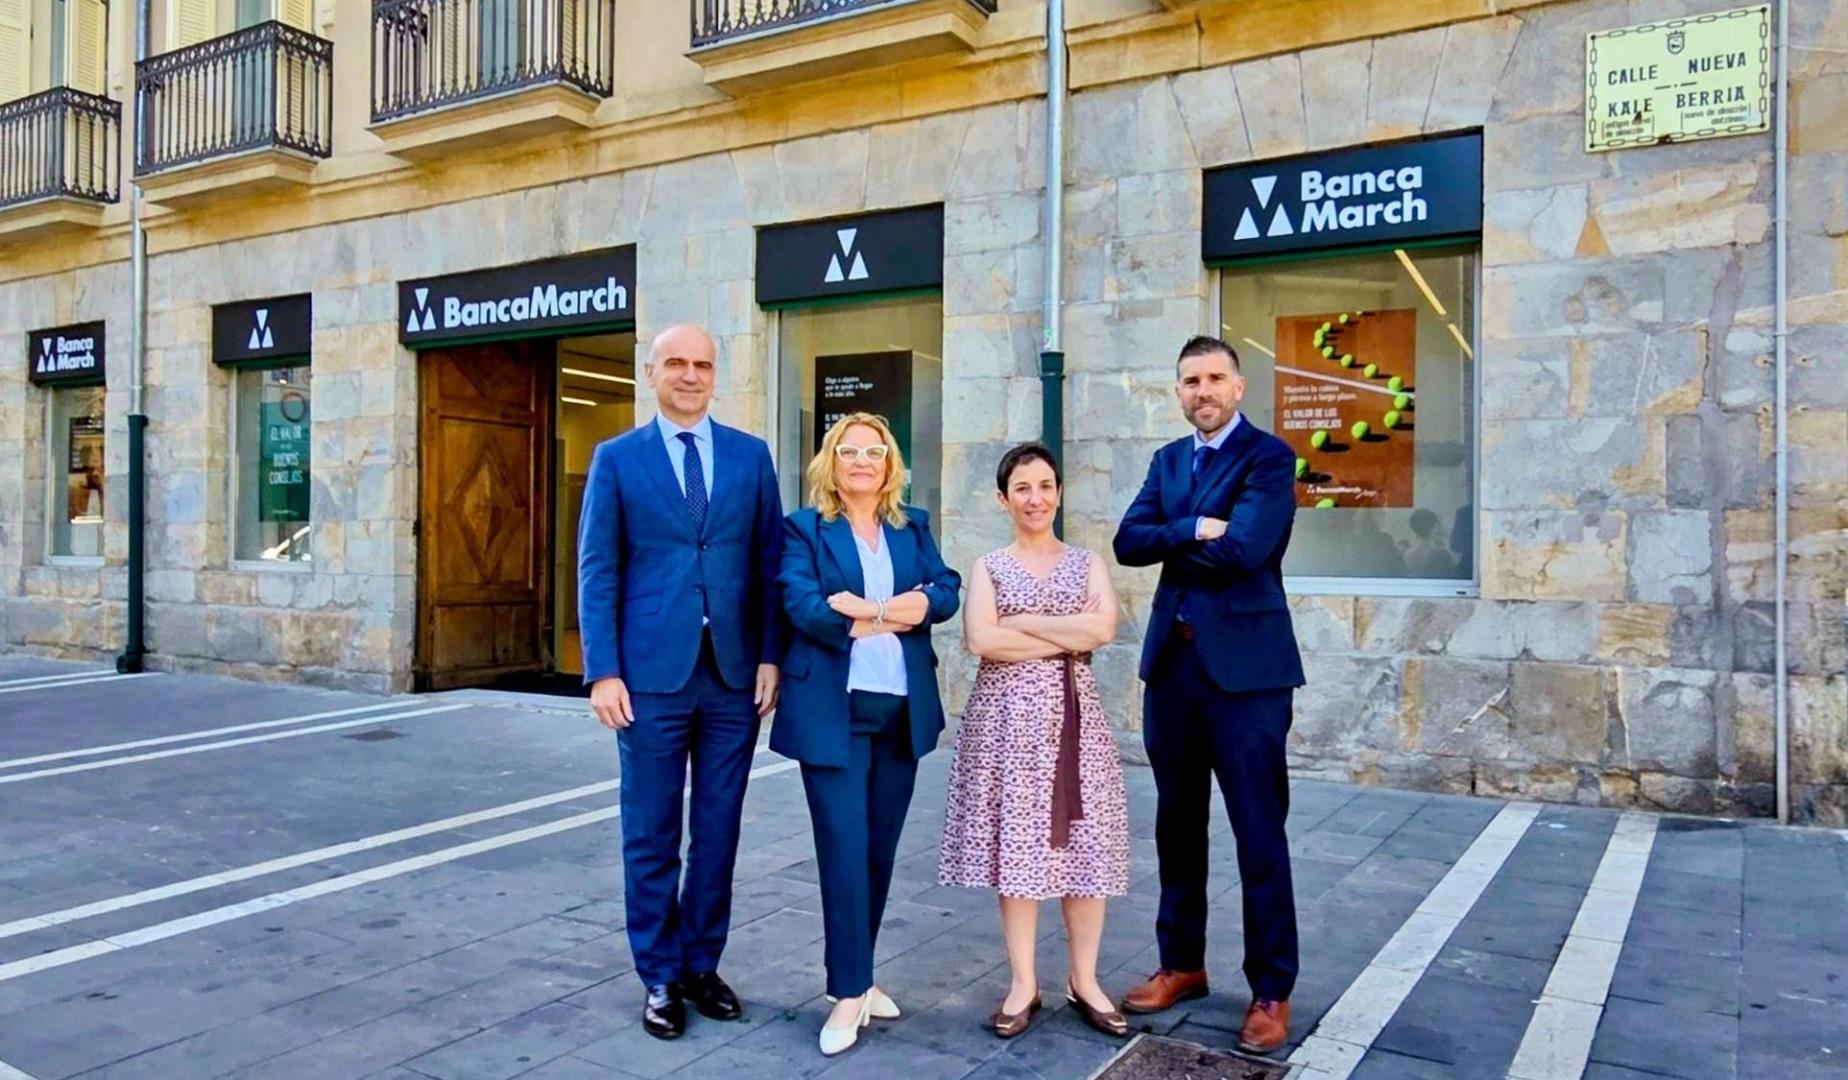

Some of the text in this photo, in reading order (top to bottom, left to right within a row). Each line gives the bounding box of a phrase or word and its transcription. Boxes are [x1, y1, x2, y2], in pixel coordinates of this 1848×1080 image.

[1608, 52, 1746, 85] CALLE NUEVA
[1608, 86, 1745, 117] KALE BERRIA
[1301, 166, 1422, 202] Banca
[1301, 191, 1427, 233] March
[444, 277, 626, 328] BancaMarch
[57, 336, 94, 353] Banca
[57, 353, 94, 370] March
[1283, 408, 1337, 418] EL VALOR DE LOS
[1283, 419, 1341, 429] BUENOS CONSEJOS
[271, 426, 278, 440] EL
[269, 470, 303, 485] CONSEJOS
